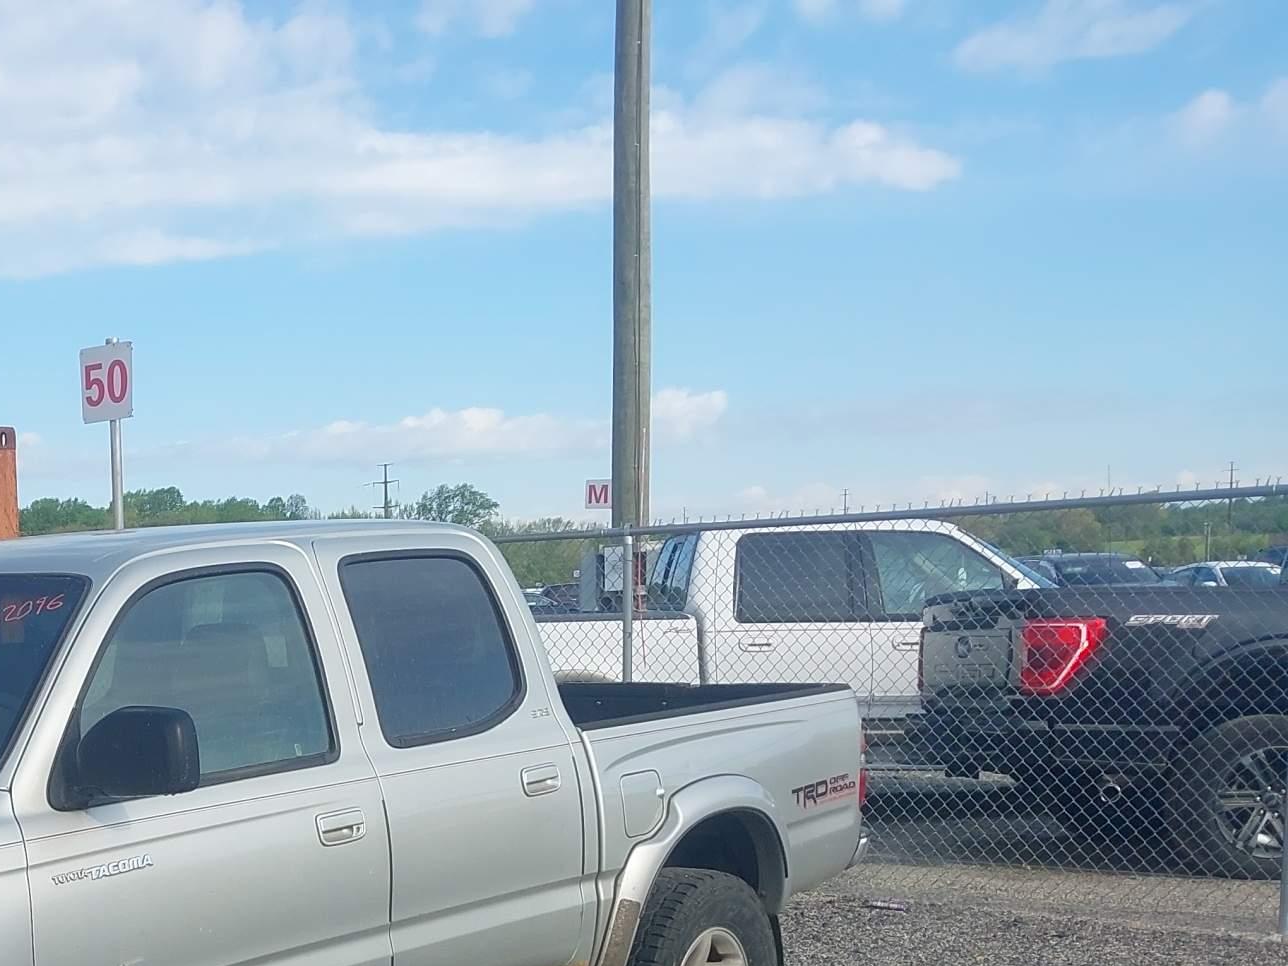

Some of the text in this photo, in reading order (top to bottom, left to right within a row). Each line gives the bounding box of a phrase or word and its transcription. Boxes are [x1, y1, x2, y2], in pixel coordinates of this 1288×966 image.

[84, 359, 128, 407] 50
[588, 484, 609, 504] M
[1125, 614, 1220, 629] SPORT
[829, 773, 849, 785] OFF
[791, 779, 828, 808] TRD
[829, 781, 856, 794] ROAD
[51, 854, 154, 886] TOYOTA TACOMA
